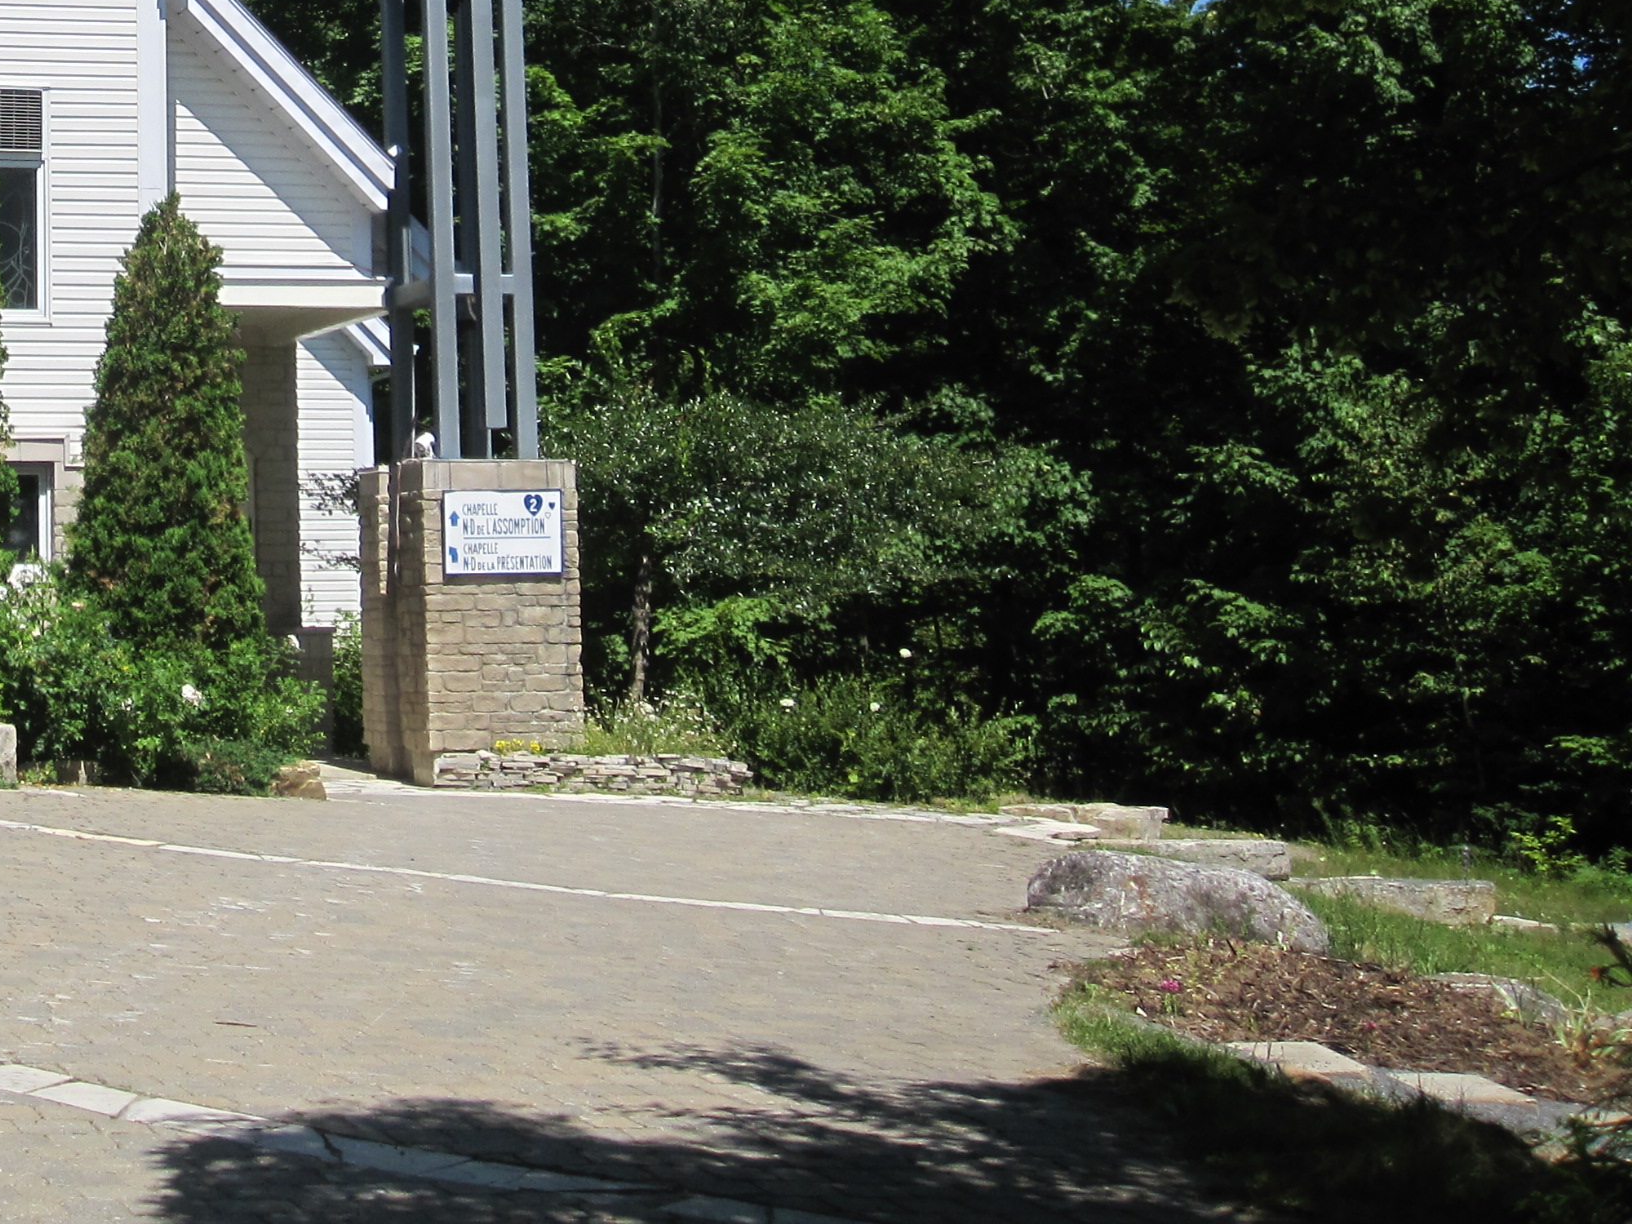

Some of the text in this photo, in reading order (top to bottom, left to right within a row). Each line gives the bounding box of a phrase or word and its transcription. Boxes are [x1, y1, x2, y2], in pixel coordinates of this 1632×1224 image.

[462, 503, 498, 515] CHAPELLE
[529, 498, 537, 512] 2
[486, 518, 544, 535] L'ASSOMPTION
[463, 543, 498, 554] CHAPELLE
[497, 554, 552, 570] PRÉSENTATION
